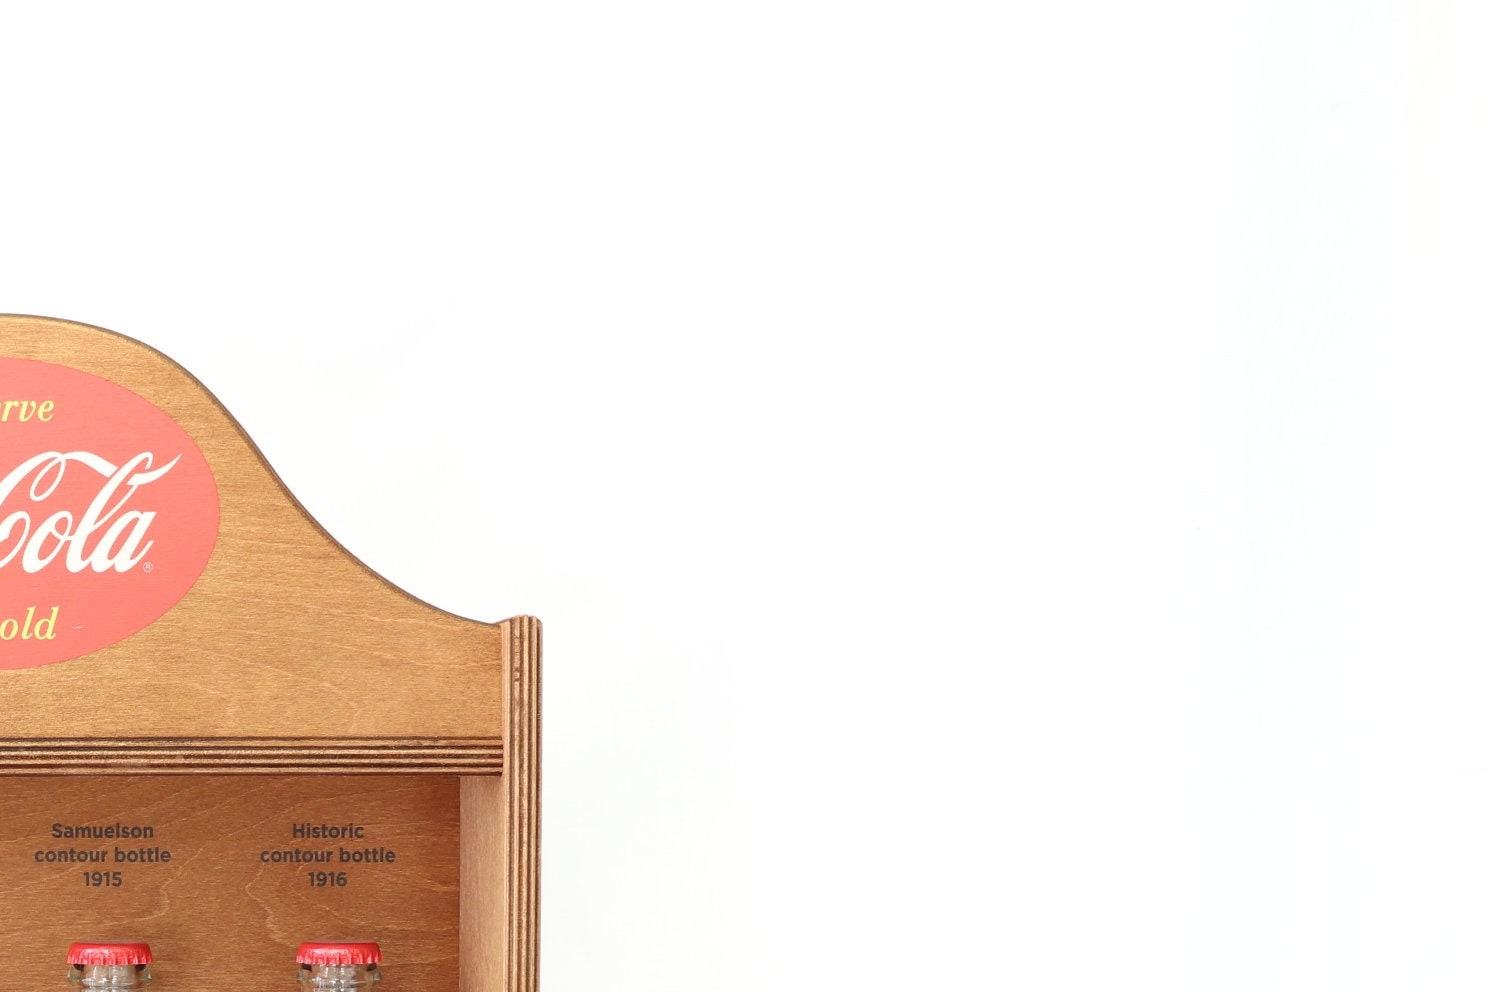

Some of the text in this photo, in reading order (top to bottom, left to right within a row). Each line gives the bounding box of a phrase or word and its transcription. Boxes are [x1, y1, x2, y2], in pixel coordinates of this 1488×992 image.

[51, 823, 154, 839] Samuelson
[292, 823, 364, 839] Historic
[34, 847, 171, 863] contour bottle
[260, 847, 396, 863] contour bottle
[83, 872, 122, 887] 1915
[308, 872, 347, 887] 1916
